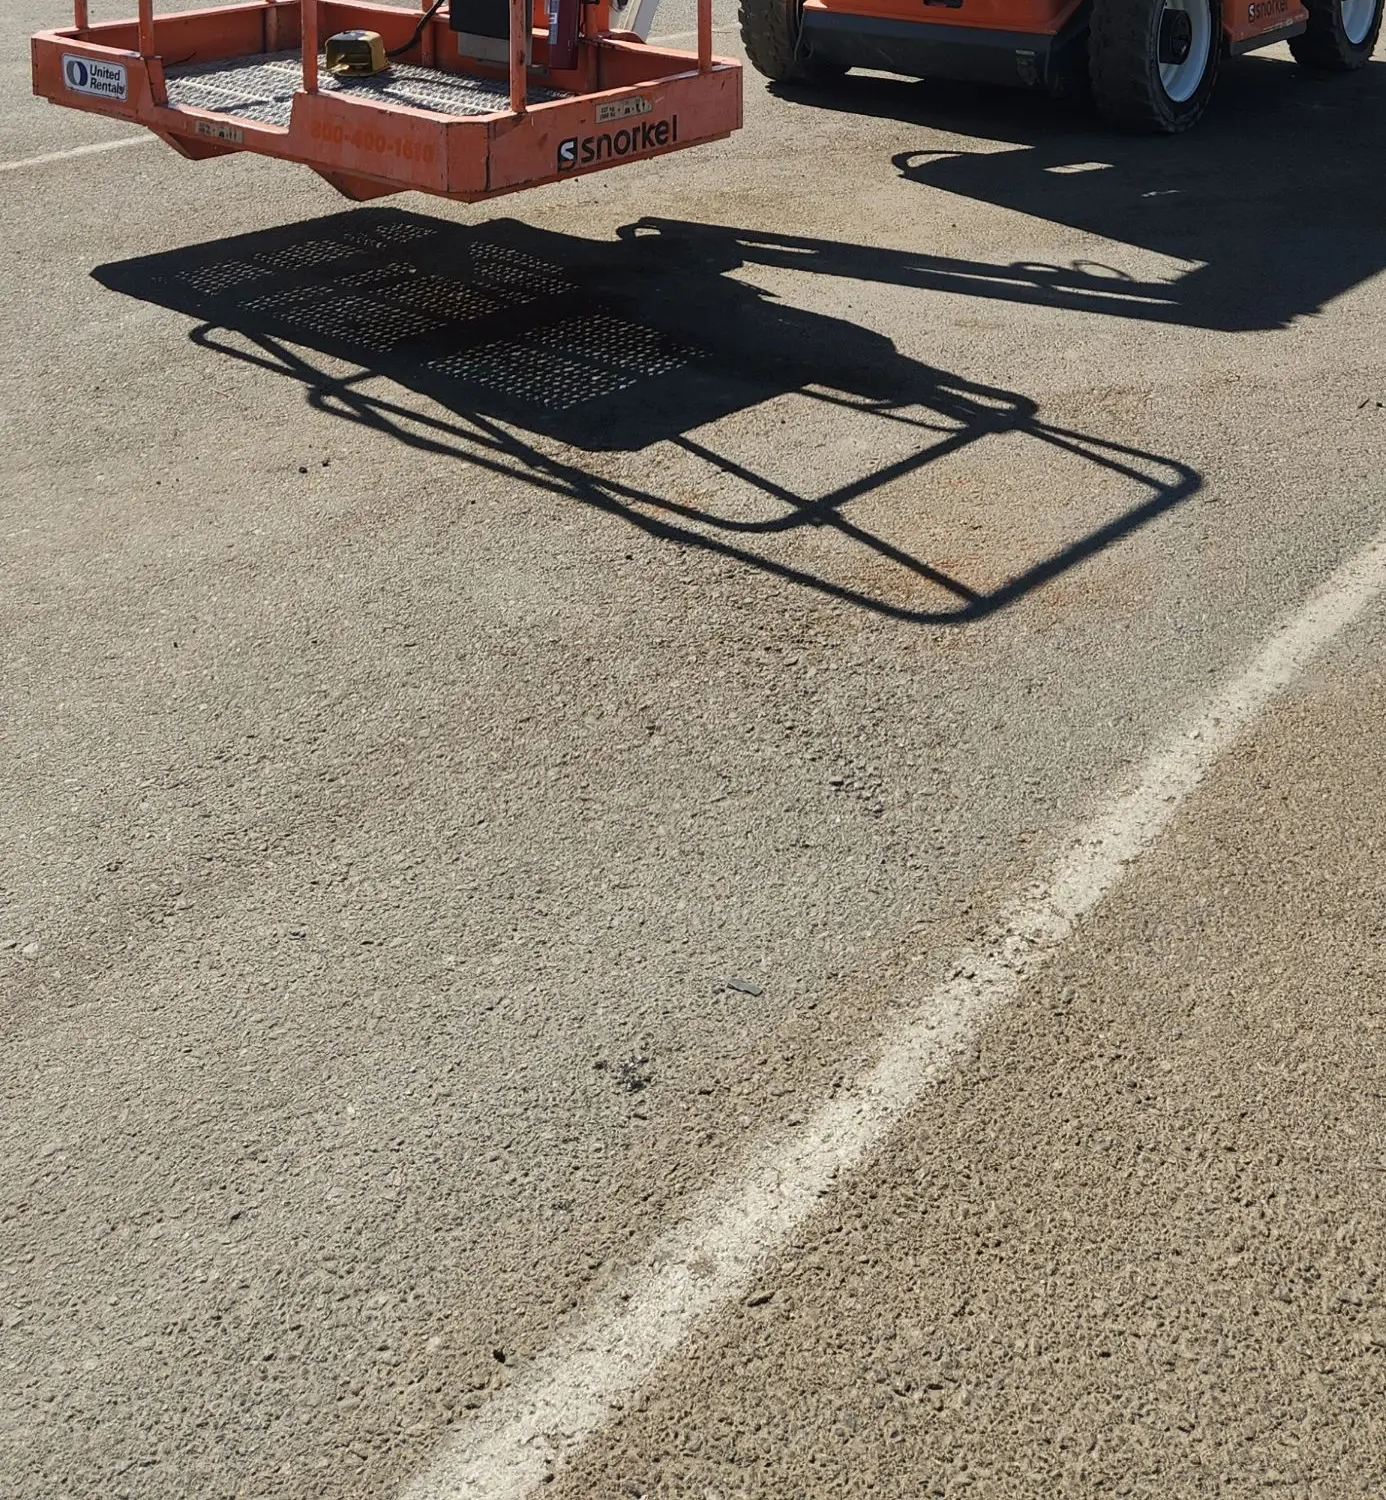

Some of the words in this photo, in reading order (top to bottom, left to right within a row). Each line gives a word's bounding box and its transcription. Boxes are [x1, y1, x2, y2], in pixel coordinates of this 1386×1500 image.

[90, 64, 121, 81] United
[90, 77, 124, 95] Rentals
[581, 114, 678, 163] snorkel
